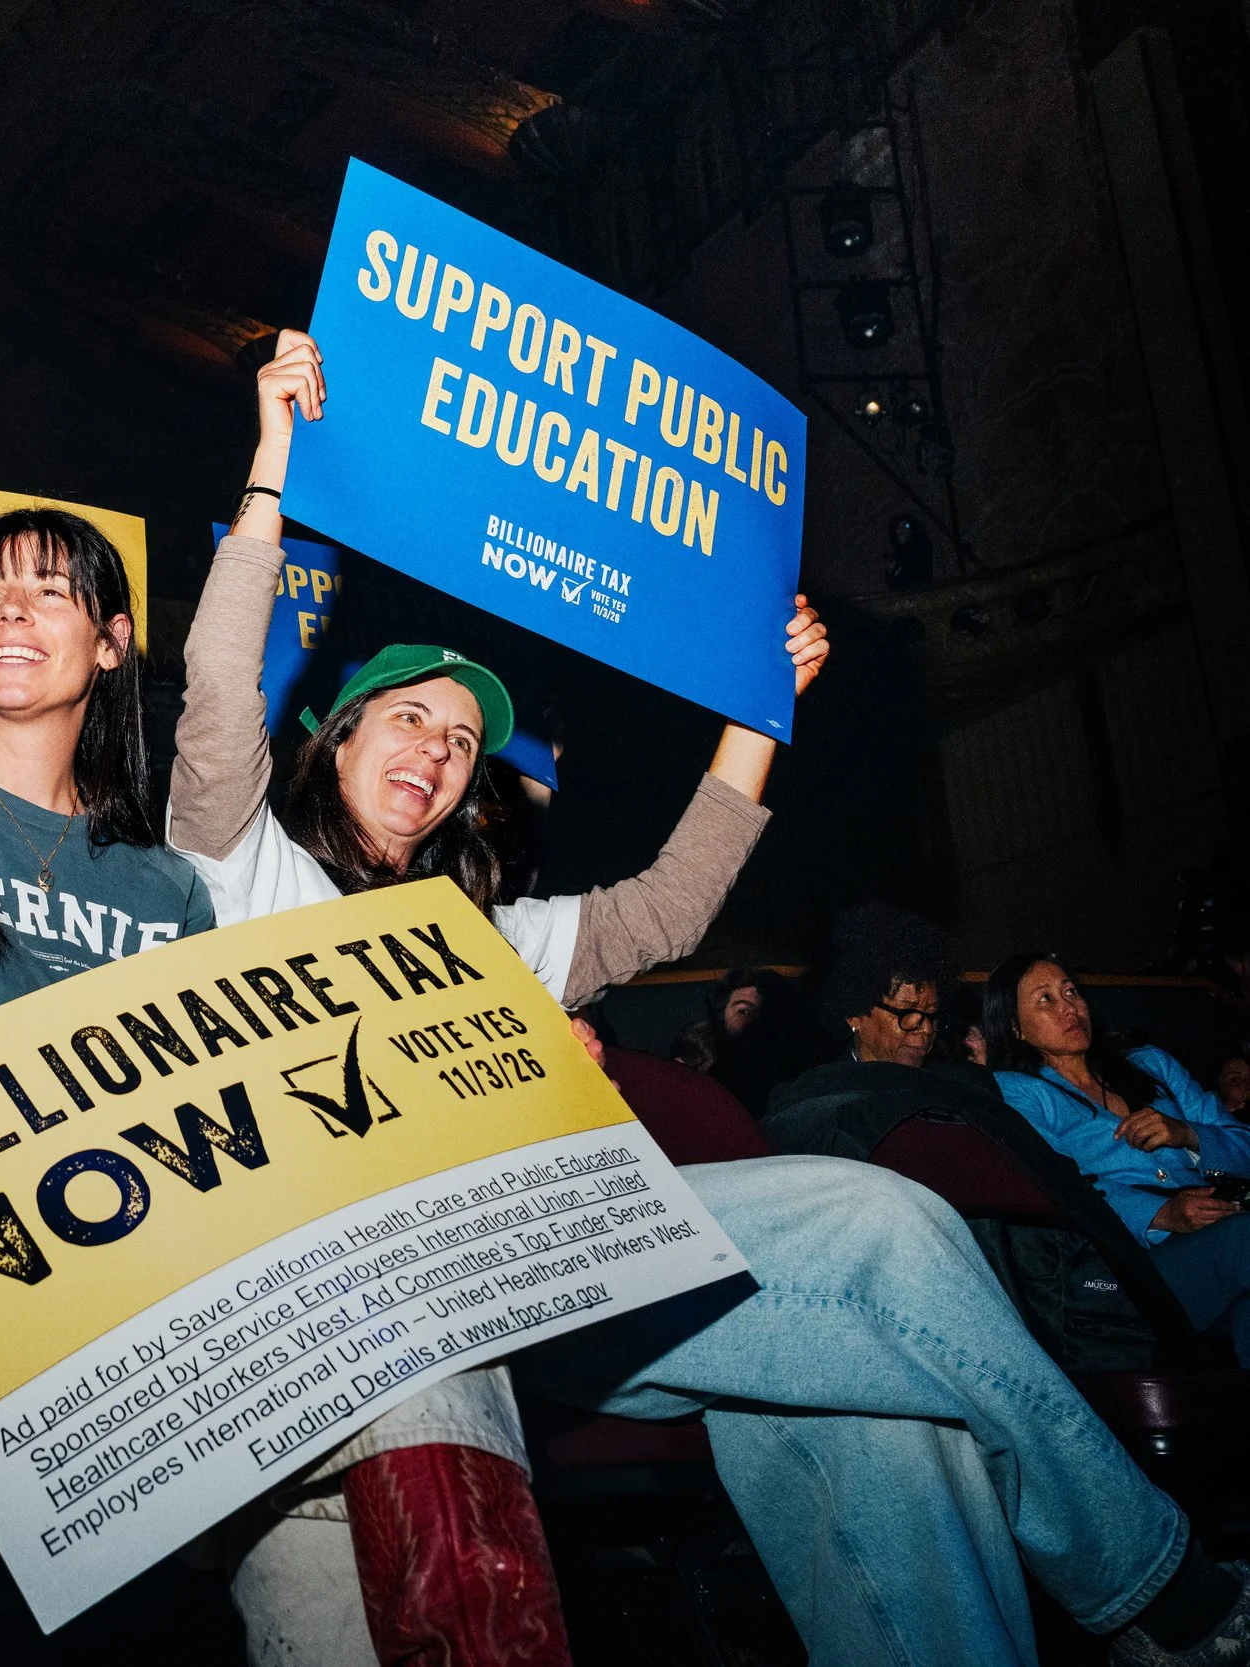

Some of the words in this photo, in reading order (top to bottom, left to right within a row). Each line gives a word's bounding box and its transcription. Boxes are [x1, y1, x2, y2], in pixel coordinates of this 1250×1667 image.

[357, 230, 617, 407] SUPPORT
[625, 359, 788, 507] PUBLIC
[420, 357, 720, 557] EDUCATION
[481, 541, 557, 592] NOW
[486, 514, 597, 581] BILLIONAIRE
[600, 563, 632, 597] TAX
[590, 589, 611, 607] VOTE
[612, 598, 627, 614] YES
[592, 603, 620, 624] 11/3/26
[346, 923, 484, 1008] TAX
[390, 1013, 477, 1066] VOTE
[461, 1006, 528, 1046] YES
[437, 1047, 546, 1102] 11/3/26
[0, 1414, 36, 1453] Ad
[39, 1377, 94, 1431] paid
[96, 1356, 130, 1388] for
[132, 1335, 167, 1364] by
[169, 1298, 234, 1341] Save
[236, 1240, 346, 1302] California
[343, 1208, 417, 1248] Health
[415, 1191, 466, 1218] Care
[467, 1174, 505, 1203] and
[501, 1163, 559, 1191] Public
[555, 1144, 639, 1176] Education,
[30, 1374, 167, 1473] Sponsored
[166, 1356, 201, 1386] by
[203, 1303, 295, 1361] Service
[294, 1242, 419, 1308] Employees
[417, 1196, 534, 1252] International
[531, 1187, 584, 1214] Union
[594, 1169, 648, 1197] United
[45, 1411, 184, 1508] Healthcare
[182, 1346, 289, 1416] Workers
[287, 1305, 361, 1351] West.
[361, 1285, 396, 1314] Ad
[513, 1230, 552, 1253] Top
[548, 1213, 608, 1243] Funder
[607, 1198, 667, 1226] Service
[40, 1455, 185, 1558] Employees
[184, 1353, 338, 1463] International
[336, 1319, 410, 1364] Union
[426, 1281, 497, 1319] United
[493, 1252, 591, 1296] Healthcare
[588, 1234, 656, 1266] Workers
[651, 1218, 701, 1247] West.
[248, 1391, 355, 1467] Funding
[350, 1344, 437, 1399] Details
[436, 1330, 463, 1354] at
[459, 1279, 608, 1345] www.fppc.ca.gov
